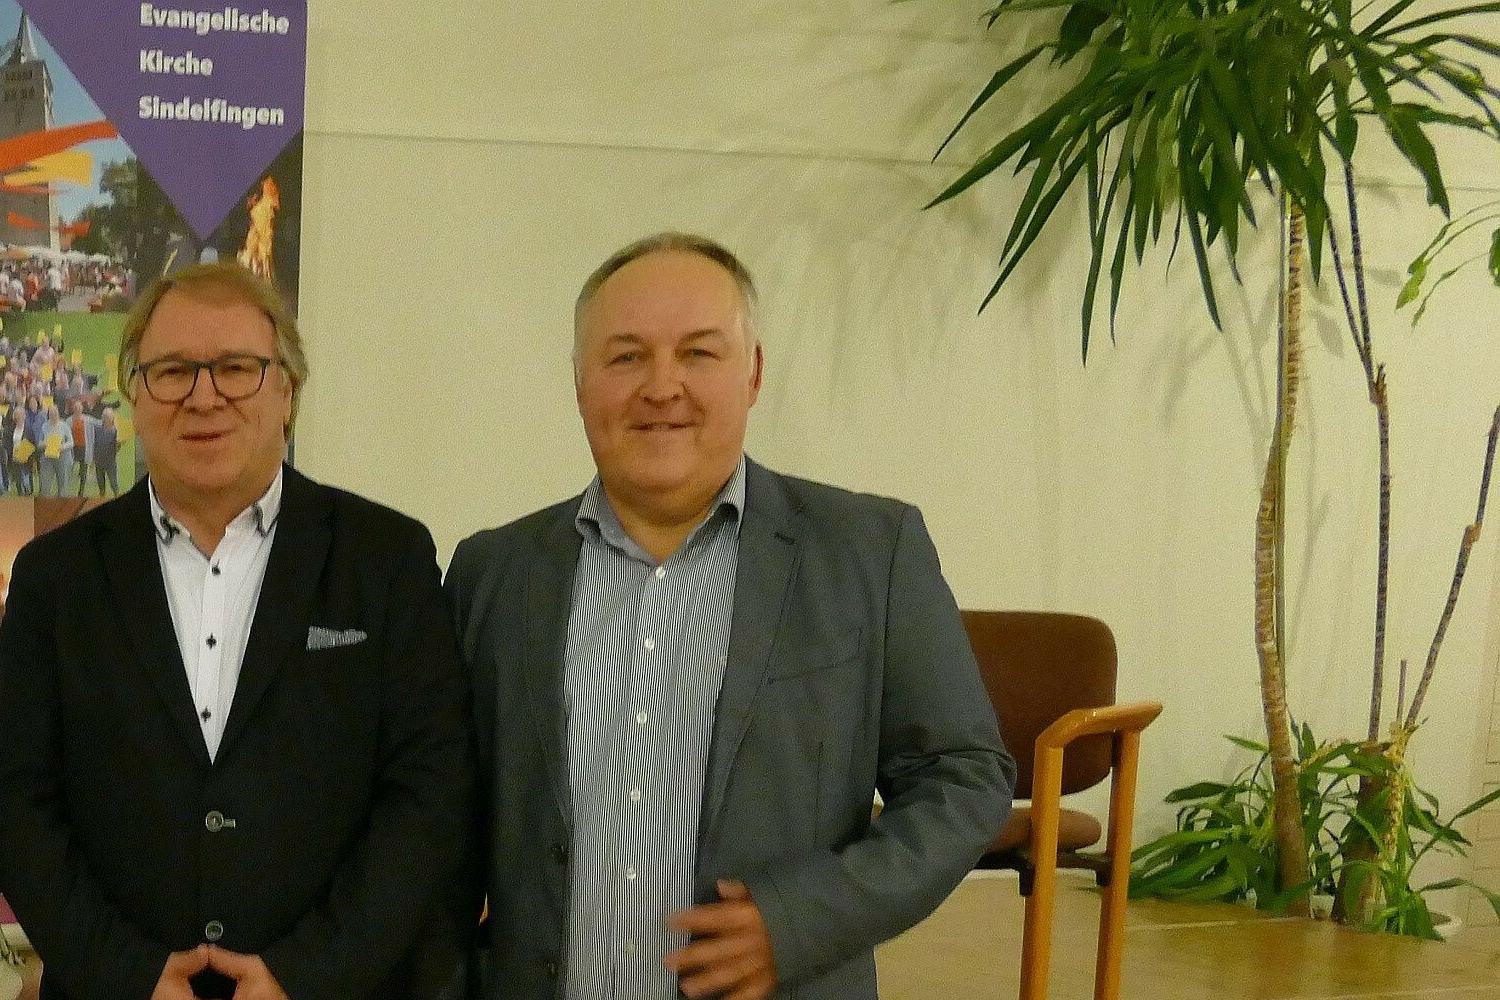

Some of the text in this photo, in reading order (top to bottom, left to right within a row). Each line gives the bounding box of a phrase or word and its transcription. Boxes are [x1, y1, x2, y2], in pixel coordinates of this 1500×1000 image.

[139, 3, 290, 35] Evangelische
[139, 49, 214, 77] Kirche
[138, 95, 285, 130] Sindelfingen
